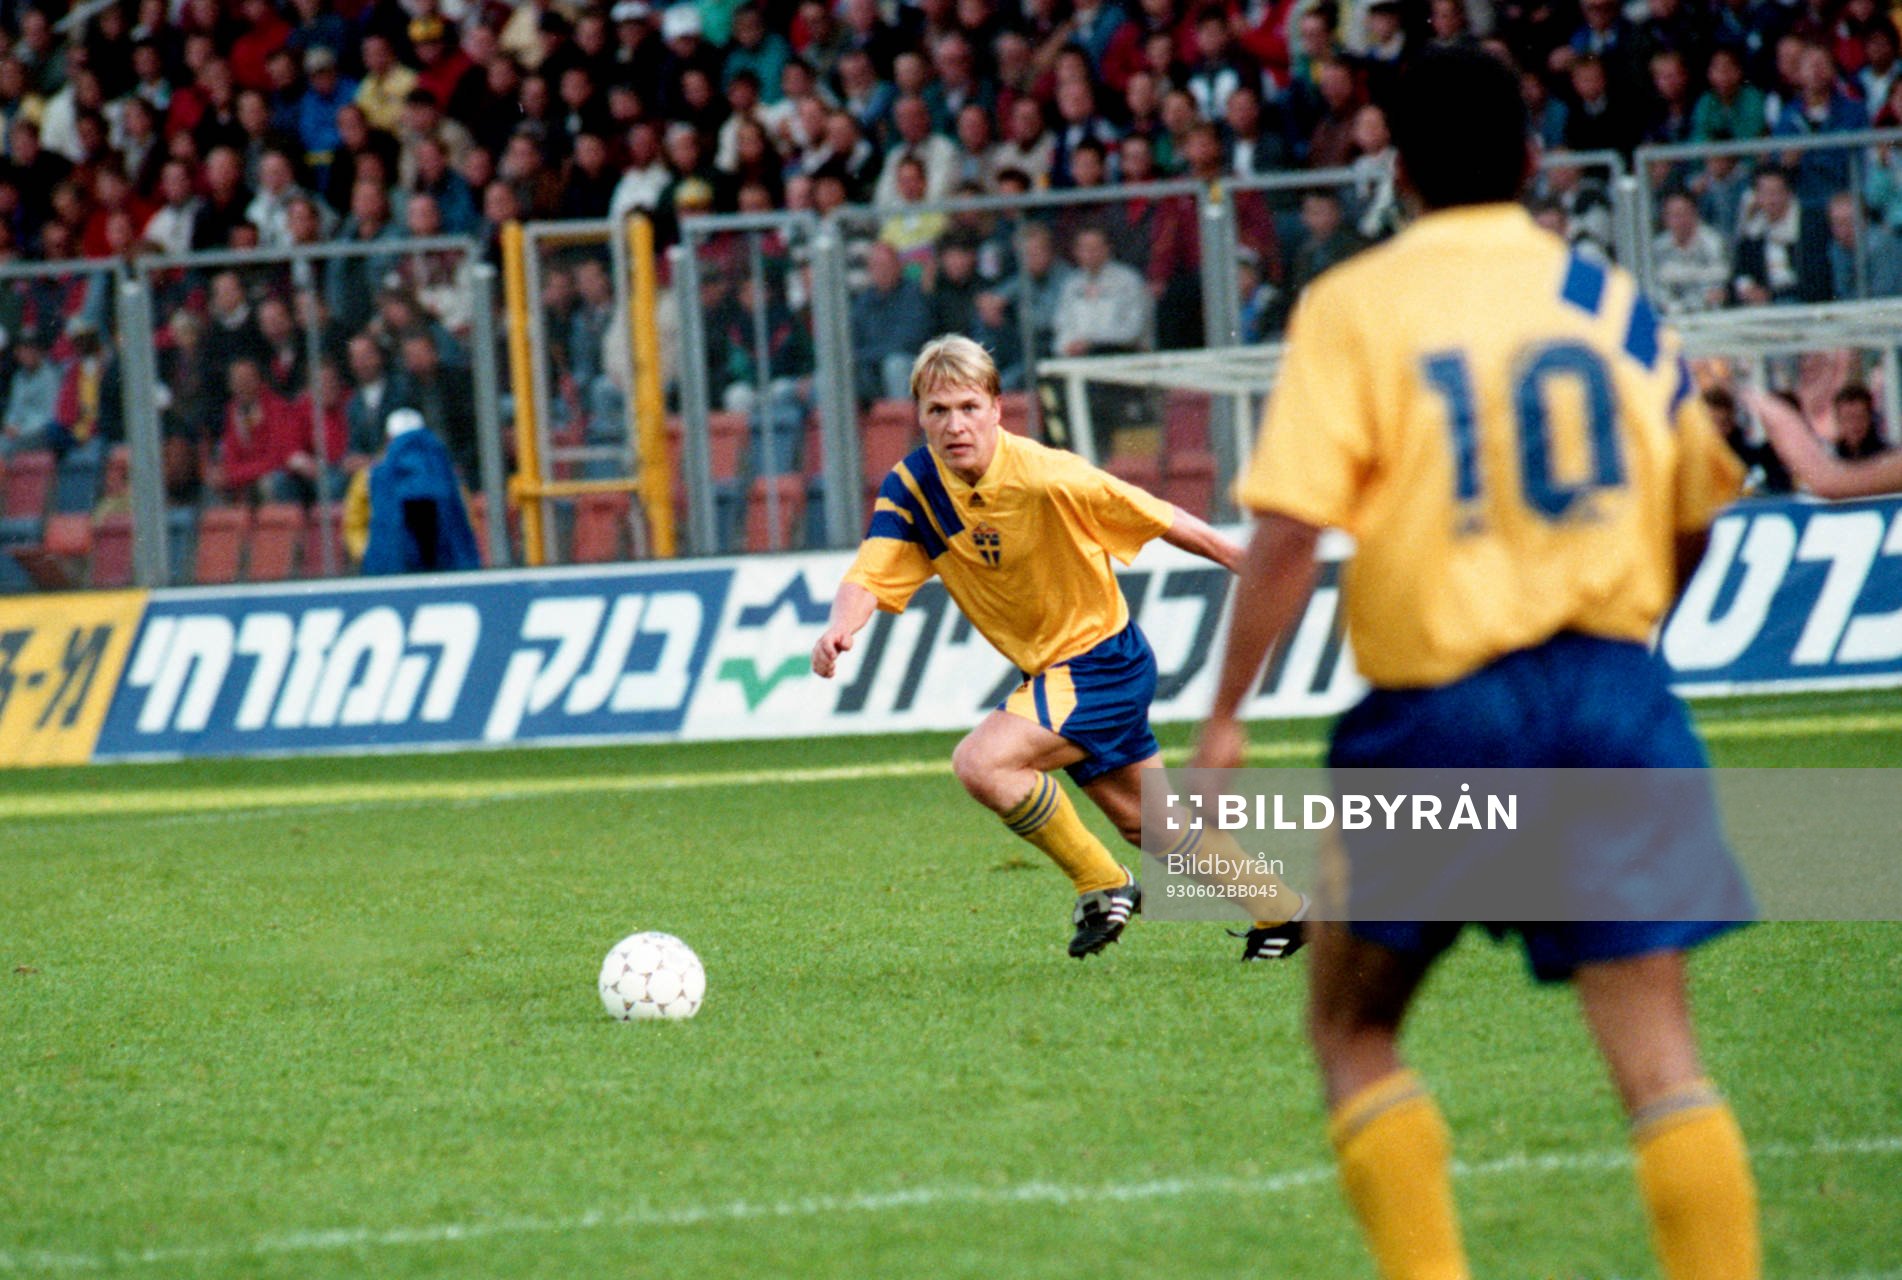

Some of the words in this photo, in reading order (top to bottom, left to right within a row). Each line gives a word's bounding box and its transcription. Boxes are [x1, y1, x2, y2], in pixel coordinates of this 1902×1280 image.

[1420, 342, 1624, 528] 10
[128, 603, 481, 733] המזרחי
[483, 591, 703, 742] בנק
